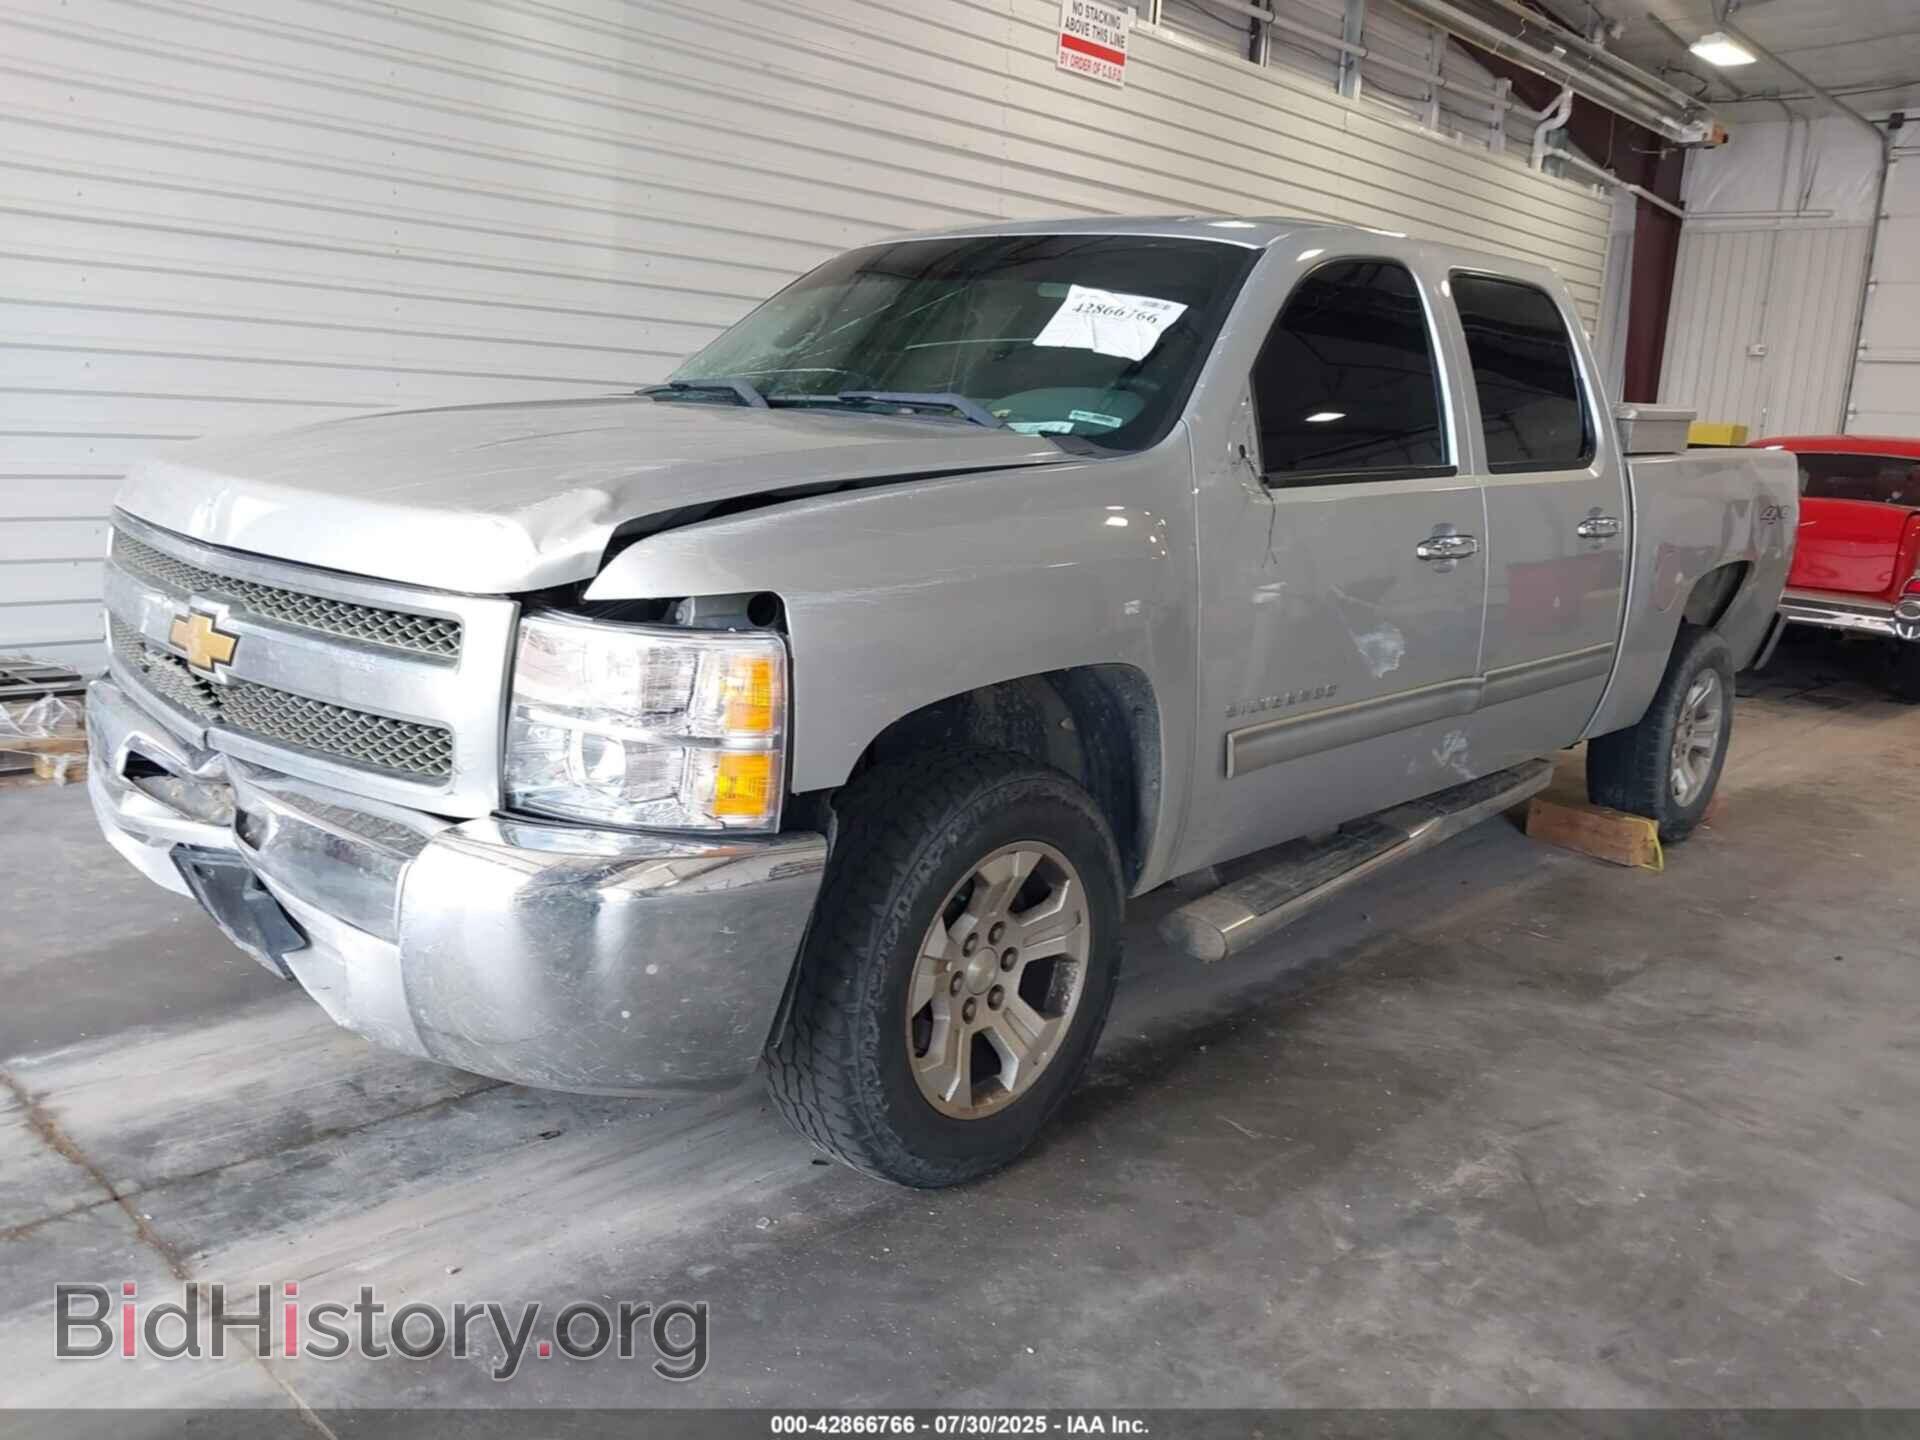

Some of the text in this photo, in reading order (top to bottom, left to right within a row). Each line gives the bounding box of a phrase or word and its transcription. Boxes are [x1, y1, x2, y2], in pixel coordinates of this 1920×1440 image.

[1072, 1, 1121, 30] NO STACKING
[1065, 16, 1126, 49] ABOVE THIS LINE
[1060, 51, 1070, 66] BY
[1070, 54, 1092, 72] ORDER
[1093, 61, 1102, 75] OF
[1071, 302, 1159, 325] 42866766
